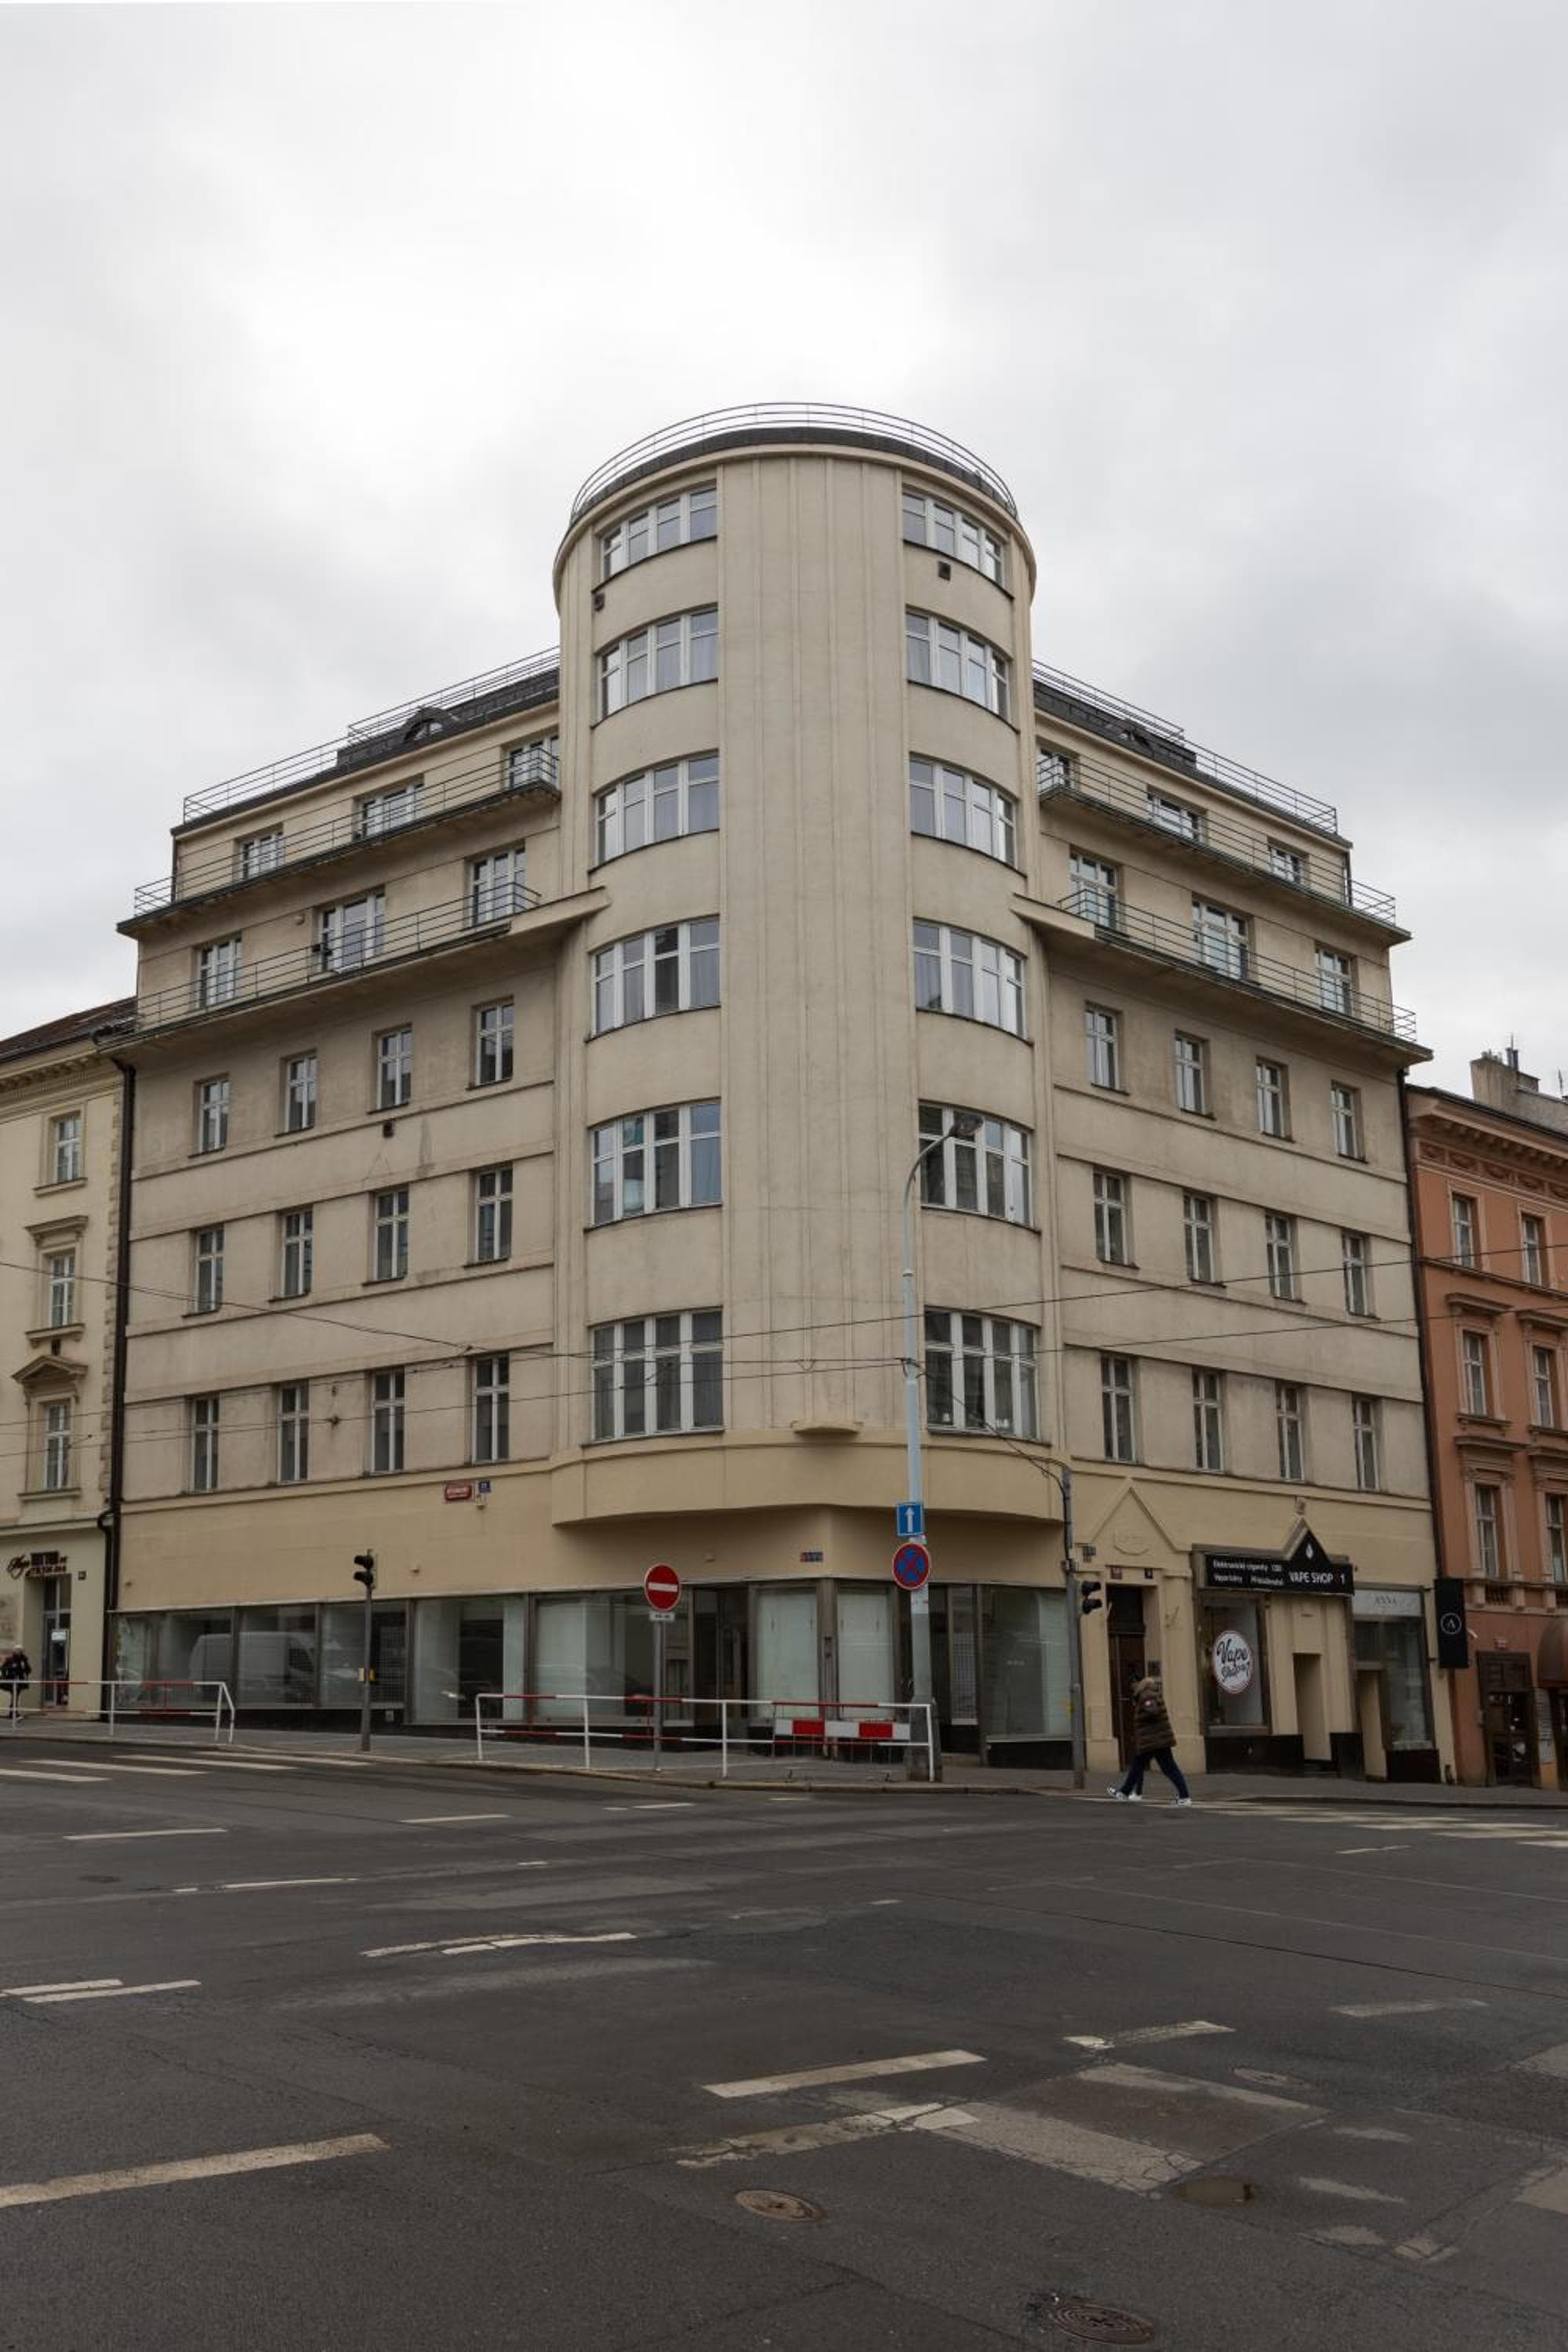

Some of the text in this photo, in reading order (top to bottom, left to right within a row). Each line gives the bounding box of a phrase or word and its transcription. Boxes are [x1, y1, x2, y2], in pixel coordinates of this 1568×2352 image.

[1289, 1571, 1310, 1583] VAPE
[1311, 1572, 1334, 1584] SHOP
[1217, 1639, 1248, 1667] Vape
